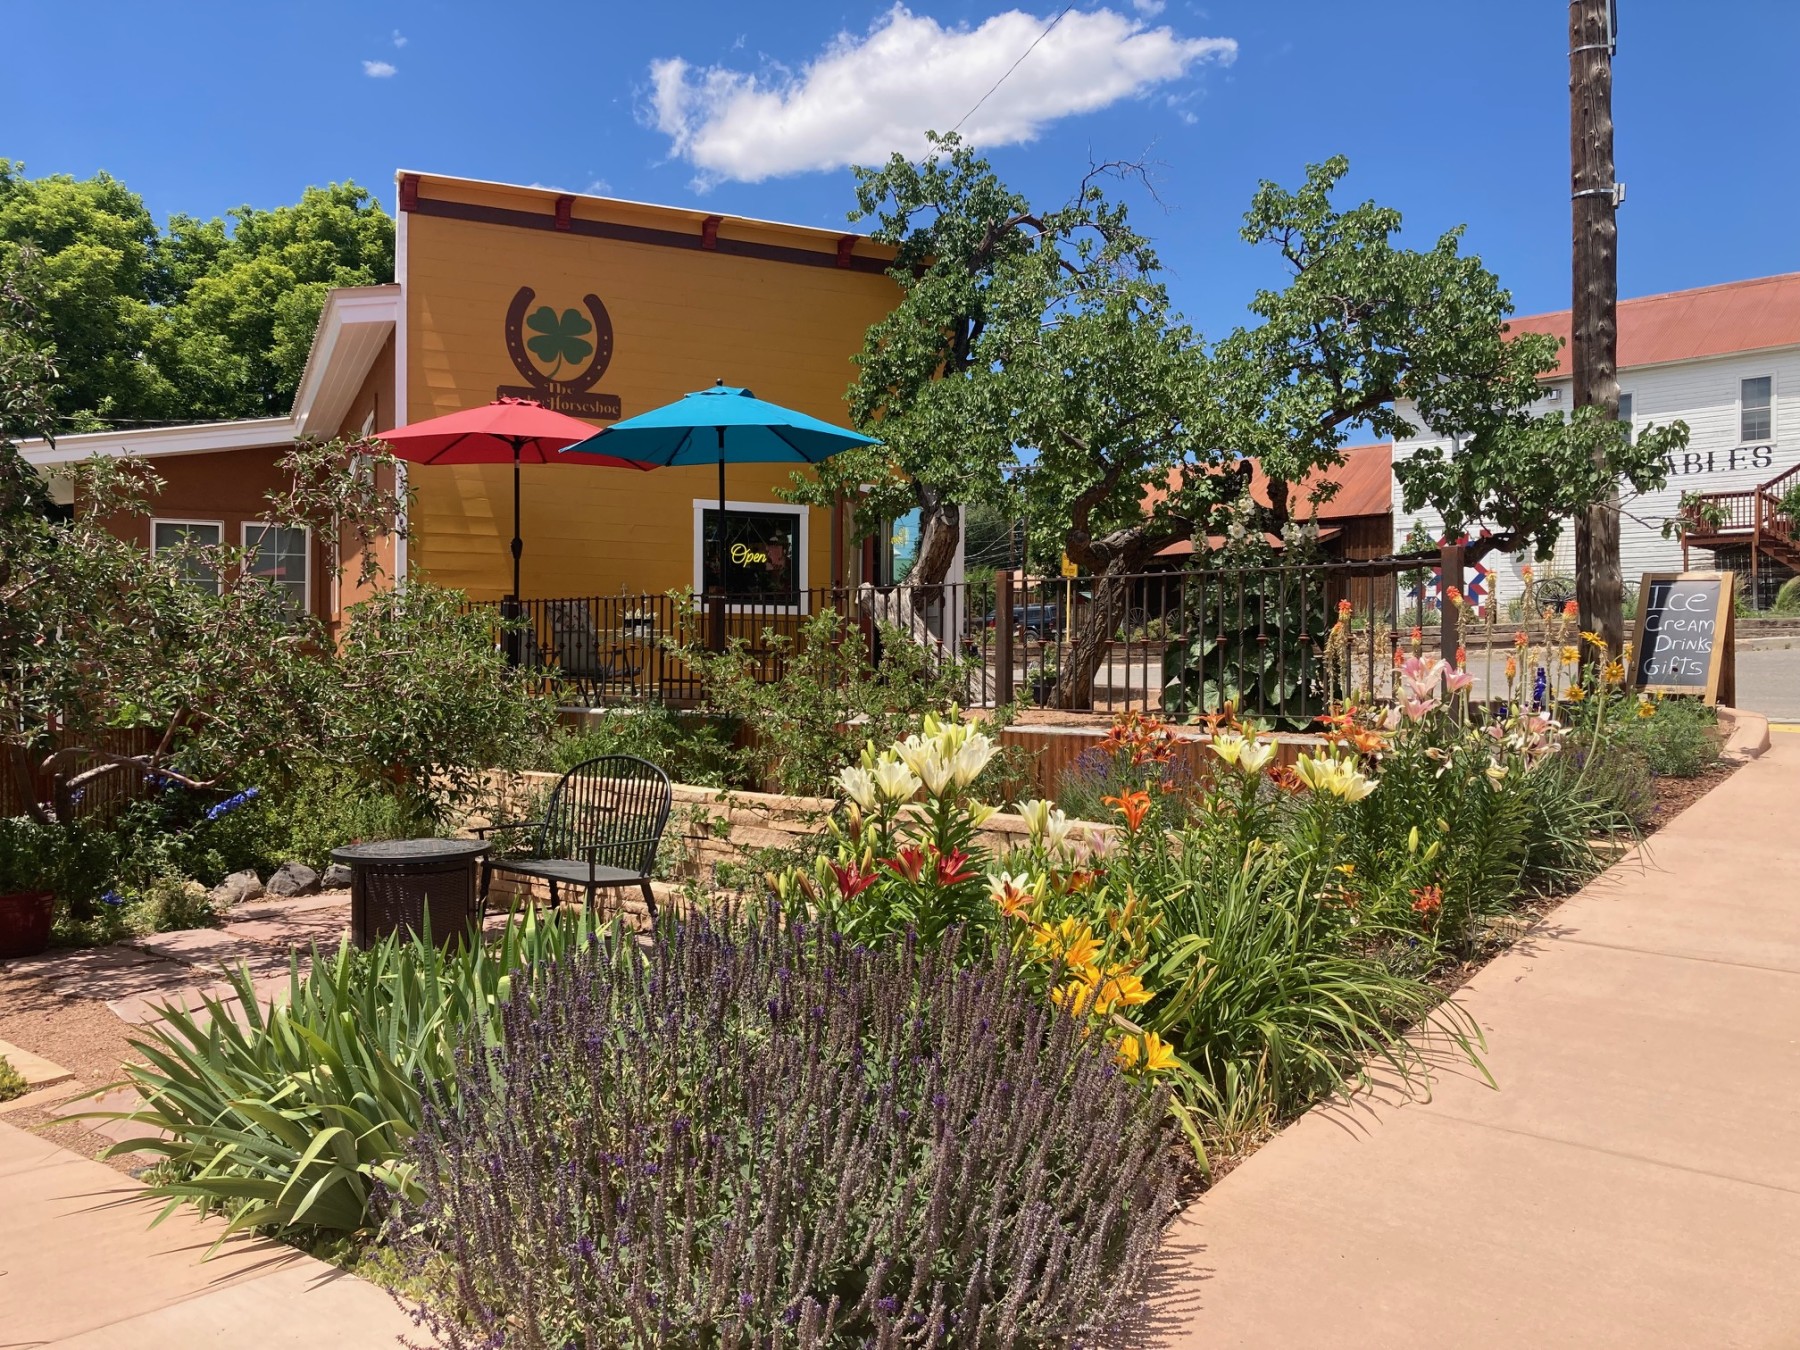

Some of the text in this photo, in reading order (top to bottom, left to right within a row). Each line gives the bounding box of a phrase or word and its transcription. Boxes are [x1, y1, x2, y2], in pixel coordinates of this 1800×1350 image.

[544, 382, 575, 395] The
[547, 395, 619, 414] Horseshoe
[731, 543, 767, 568] Open
[1647, 585, 1710, 612] Ice
